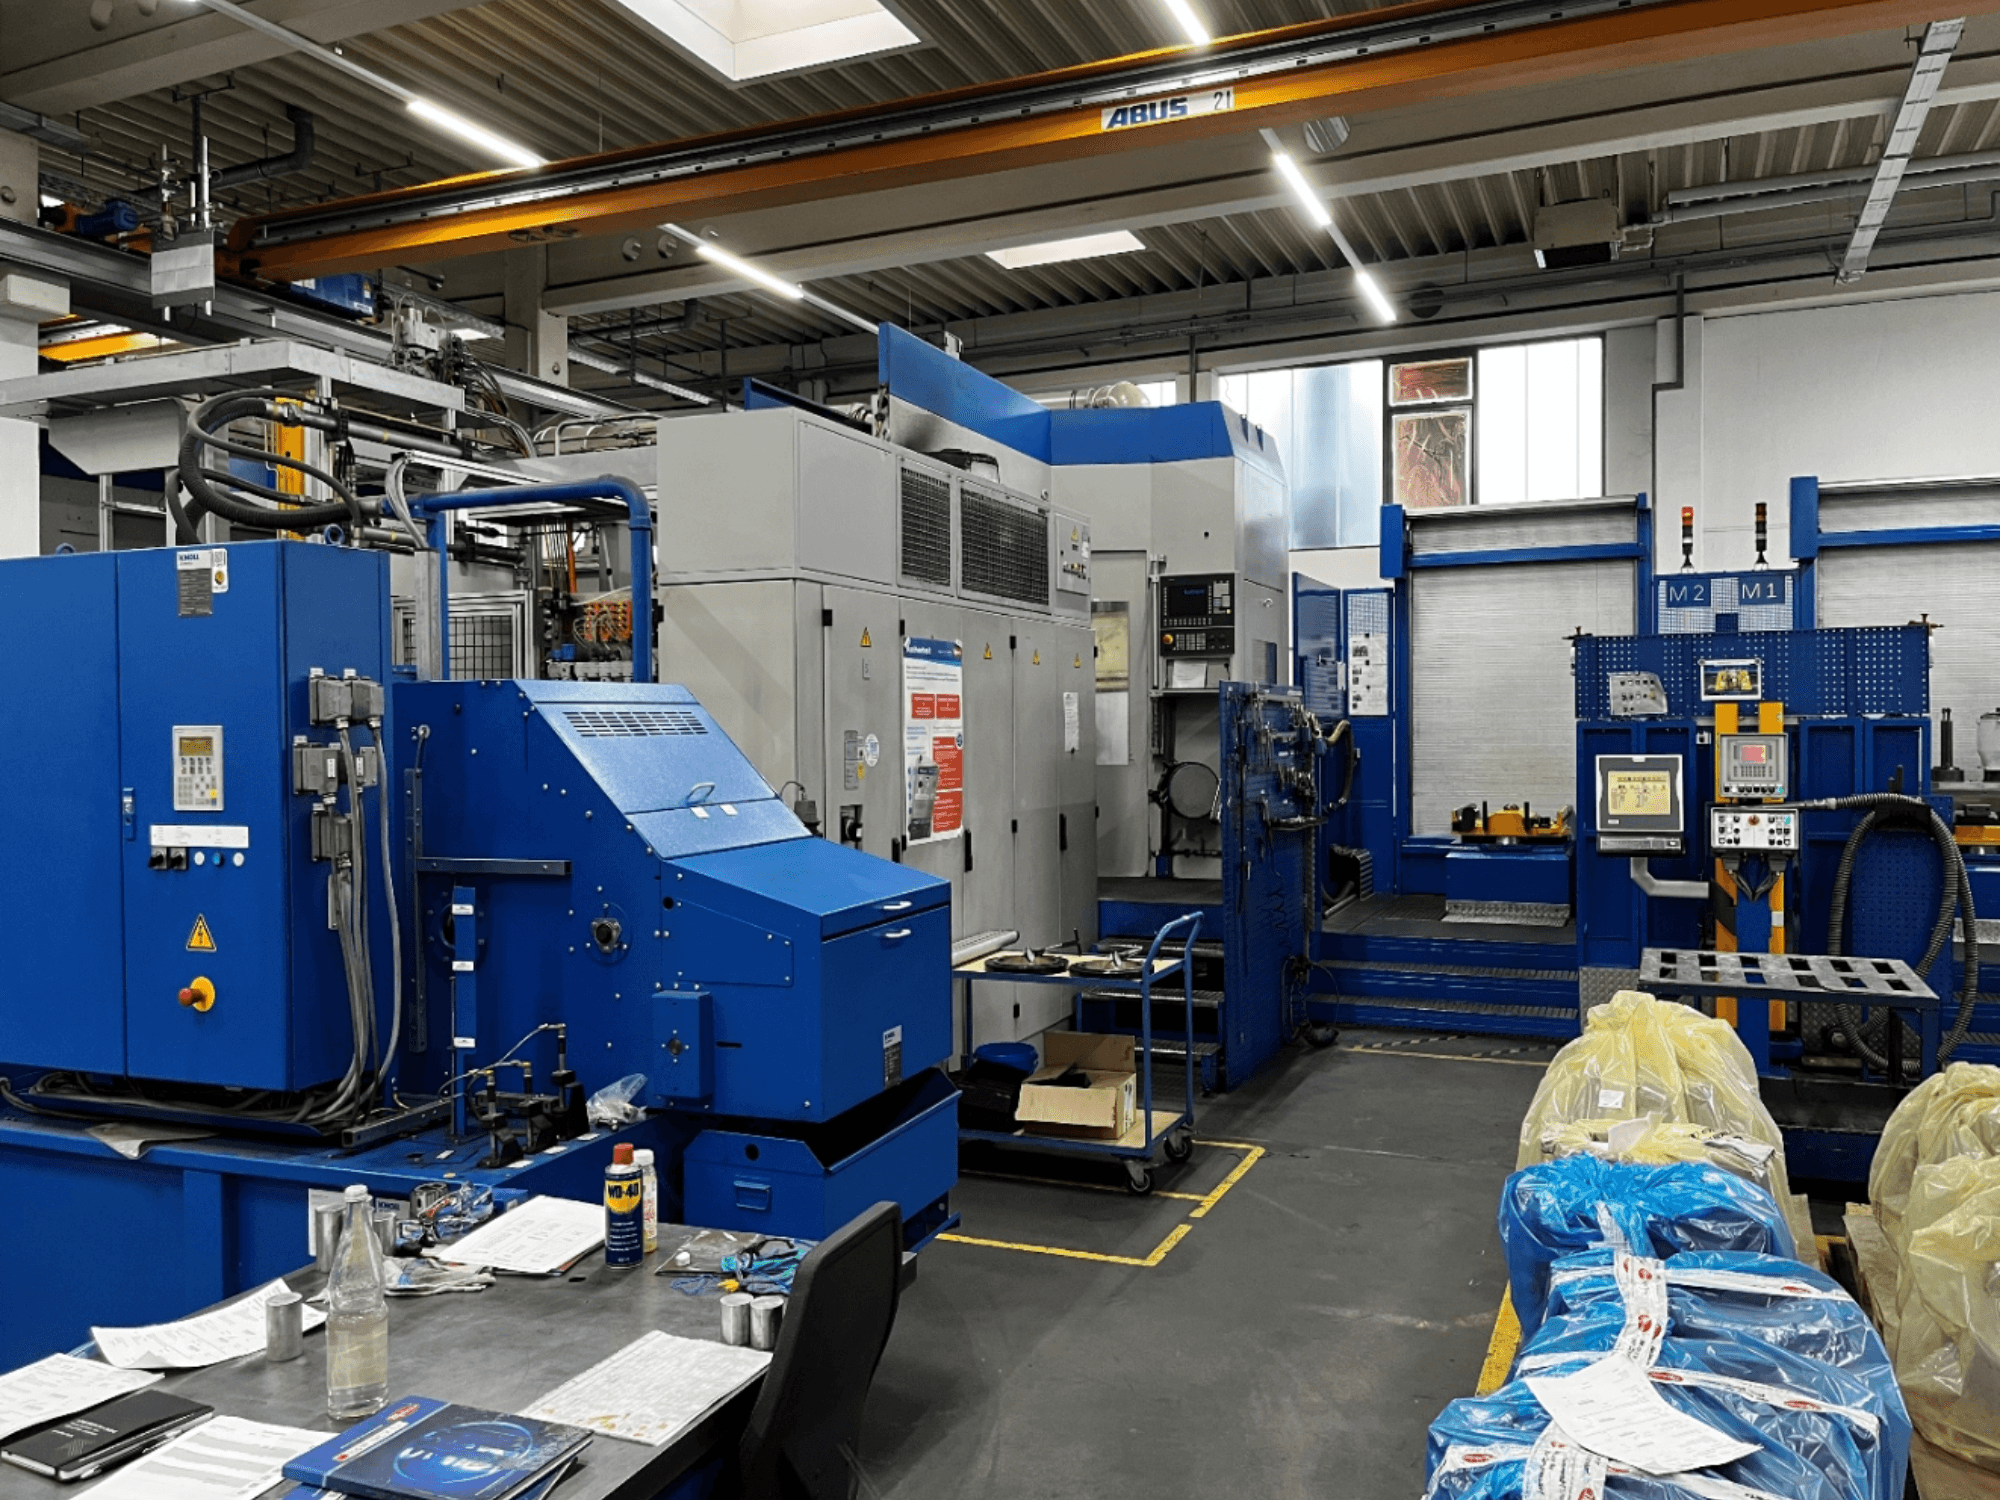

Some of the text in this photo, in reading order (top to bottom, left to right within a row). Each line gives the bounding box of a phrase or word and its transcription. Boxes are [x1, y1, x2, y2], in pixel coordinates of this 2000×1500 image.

[1106, 97, 1188, 129] ABUS
[1669, 584, 1705, 602] M 2
[1742, 583, 1778, 600] M 1
[607, 1182, 639, 1199] WD-40
